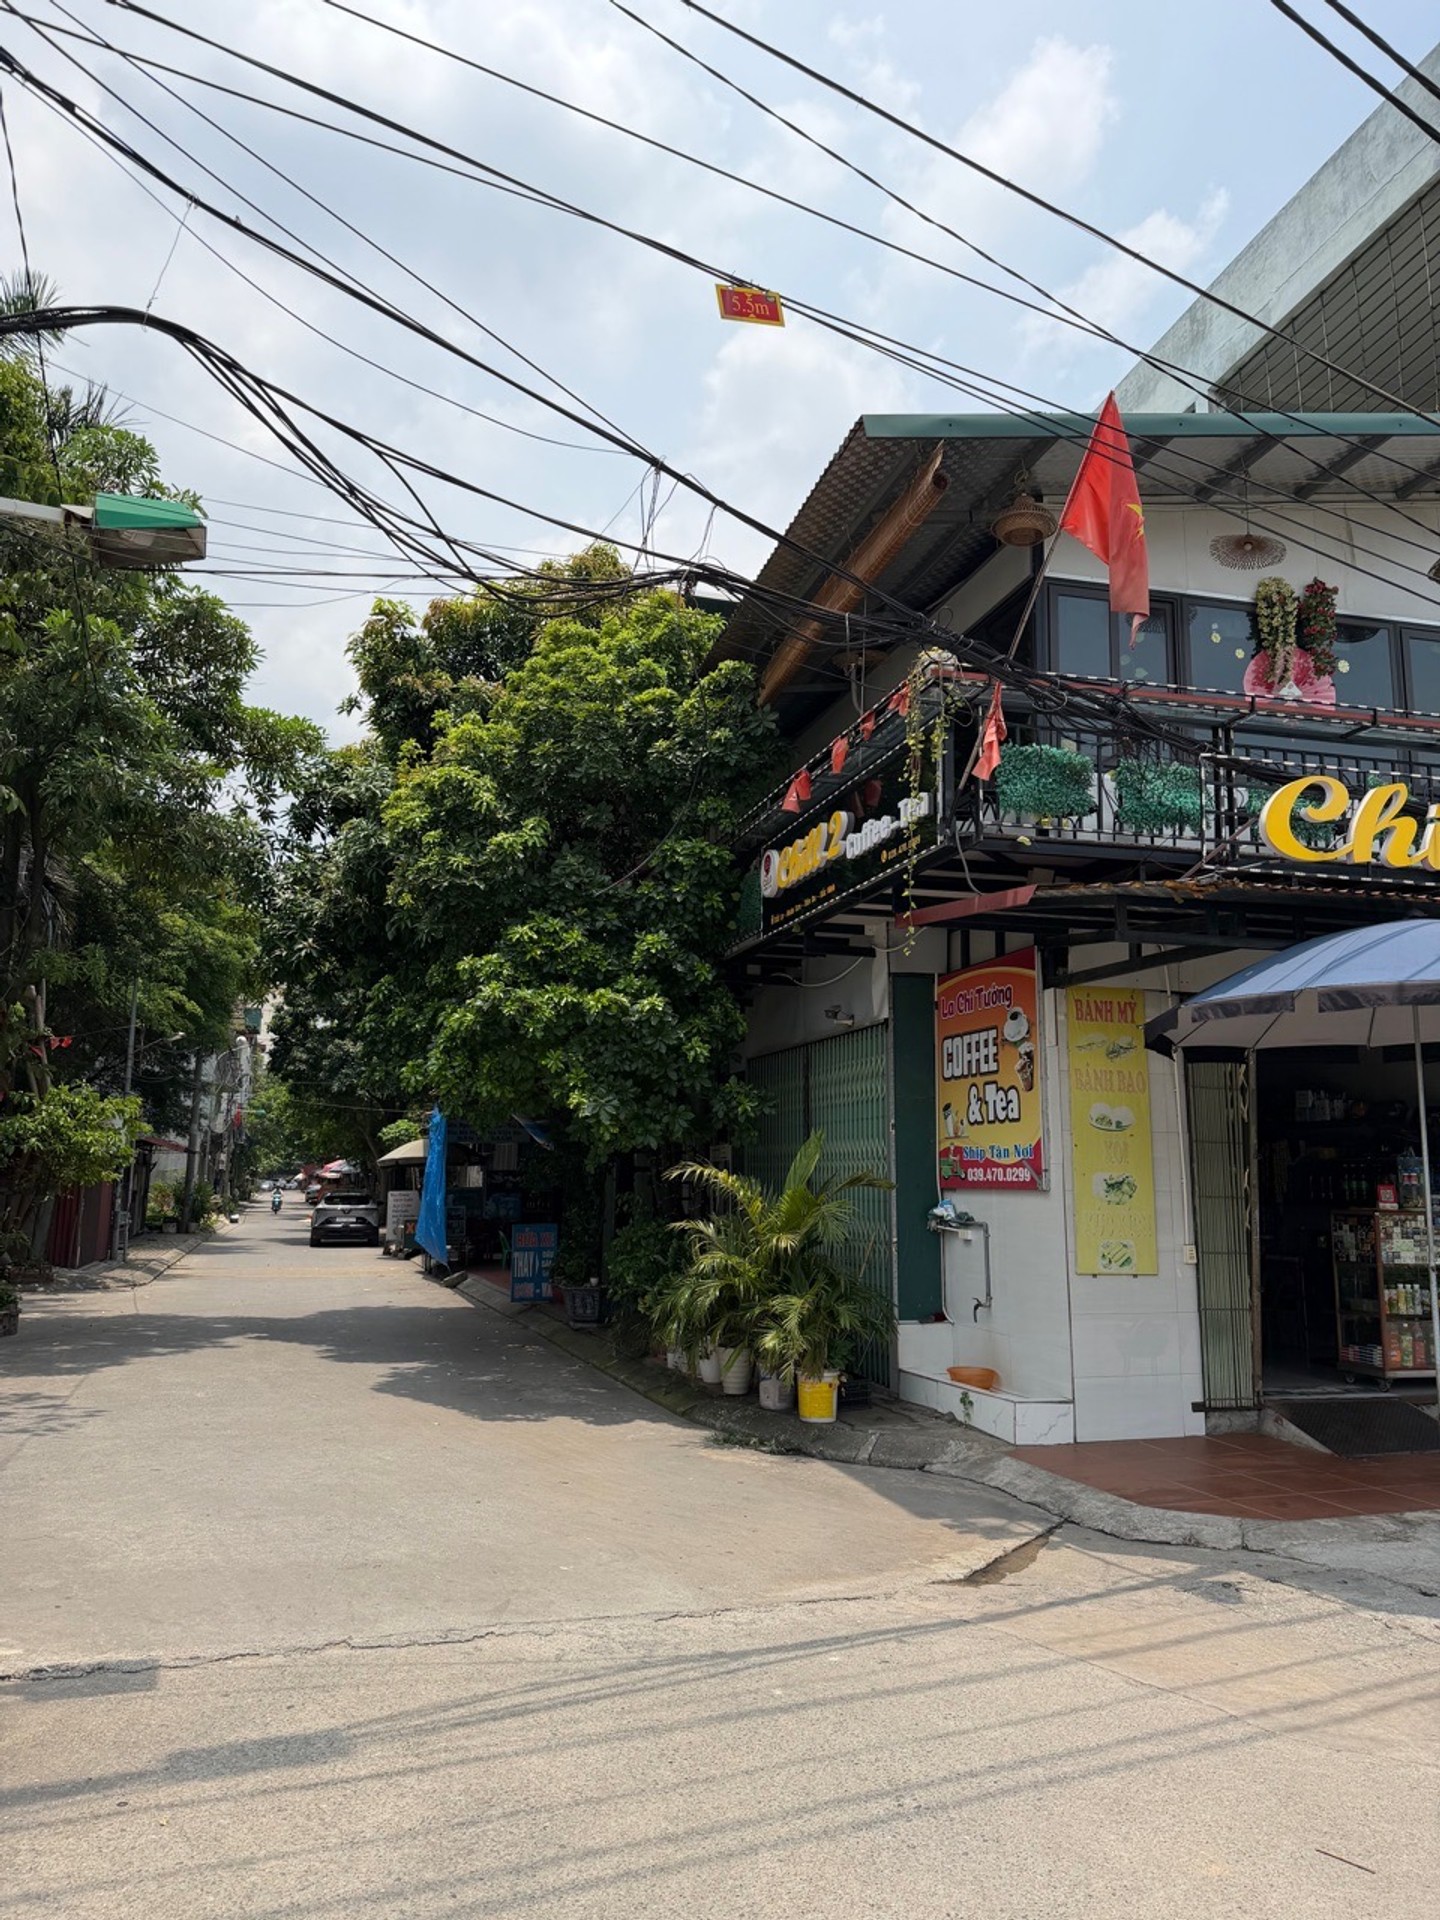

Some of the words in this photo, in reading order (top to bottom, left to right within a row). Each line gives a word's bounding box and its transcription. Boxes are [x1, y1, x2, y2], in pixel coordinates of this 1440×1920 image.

[732, 295, 769, 315] 5.5m
[828, 810, 848, 860] 2
[957, 988, 975, 1015] Chi
[1074, 992, 1113, 1023] BÁNH
[943, 1027, 999, 1079] COFFEE
[1117, 1069, 1146, 1095] BAO
[968, 1083, 984, 1125] &
[984, 1083, 1020, 1124] Tea
[963, 1146, 985, 1161] Ship
